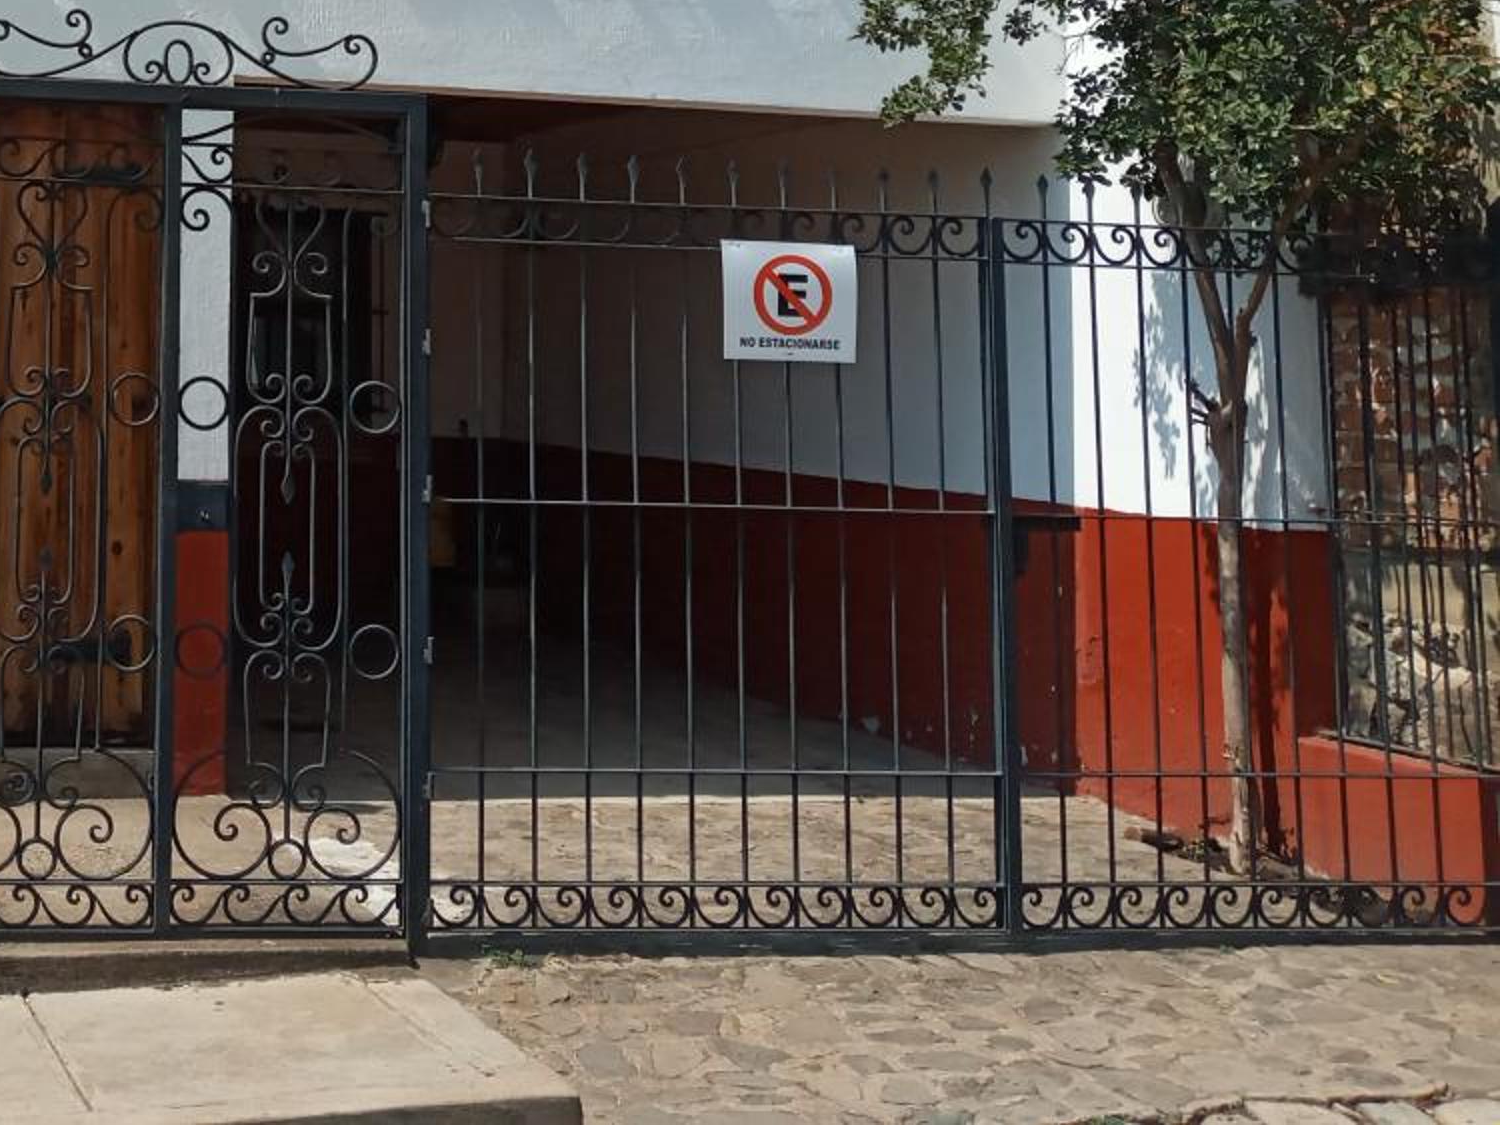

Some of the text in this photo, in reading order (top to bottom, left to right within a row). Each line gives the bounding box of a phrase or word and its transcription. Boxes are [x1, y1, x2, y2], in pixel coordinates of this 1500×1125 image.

[778, 273, 808, 316] E
[740, 337, 841, 350] NO ESTACIONARSE
